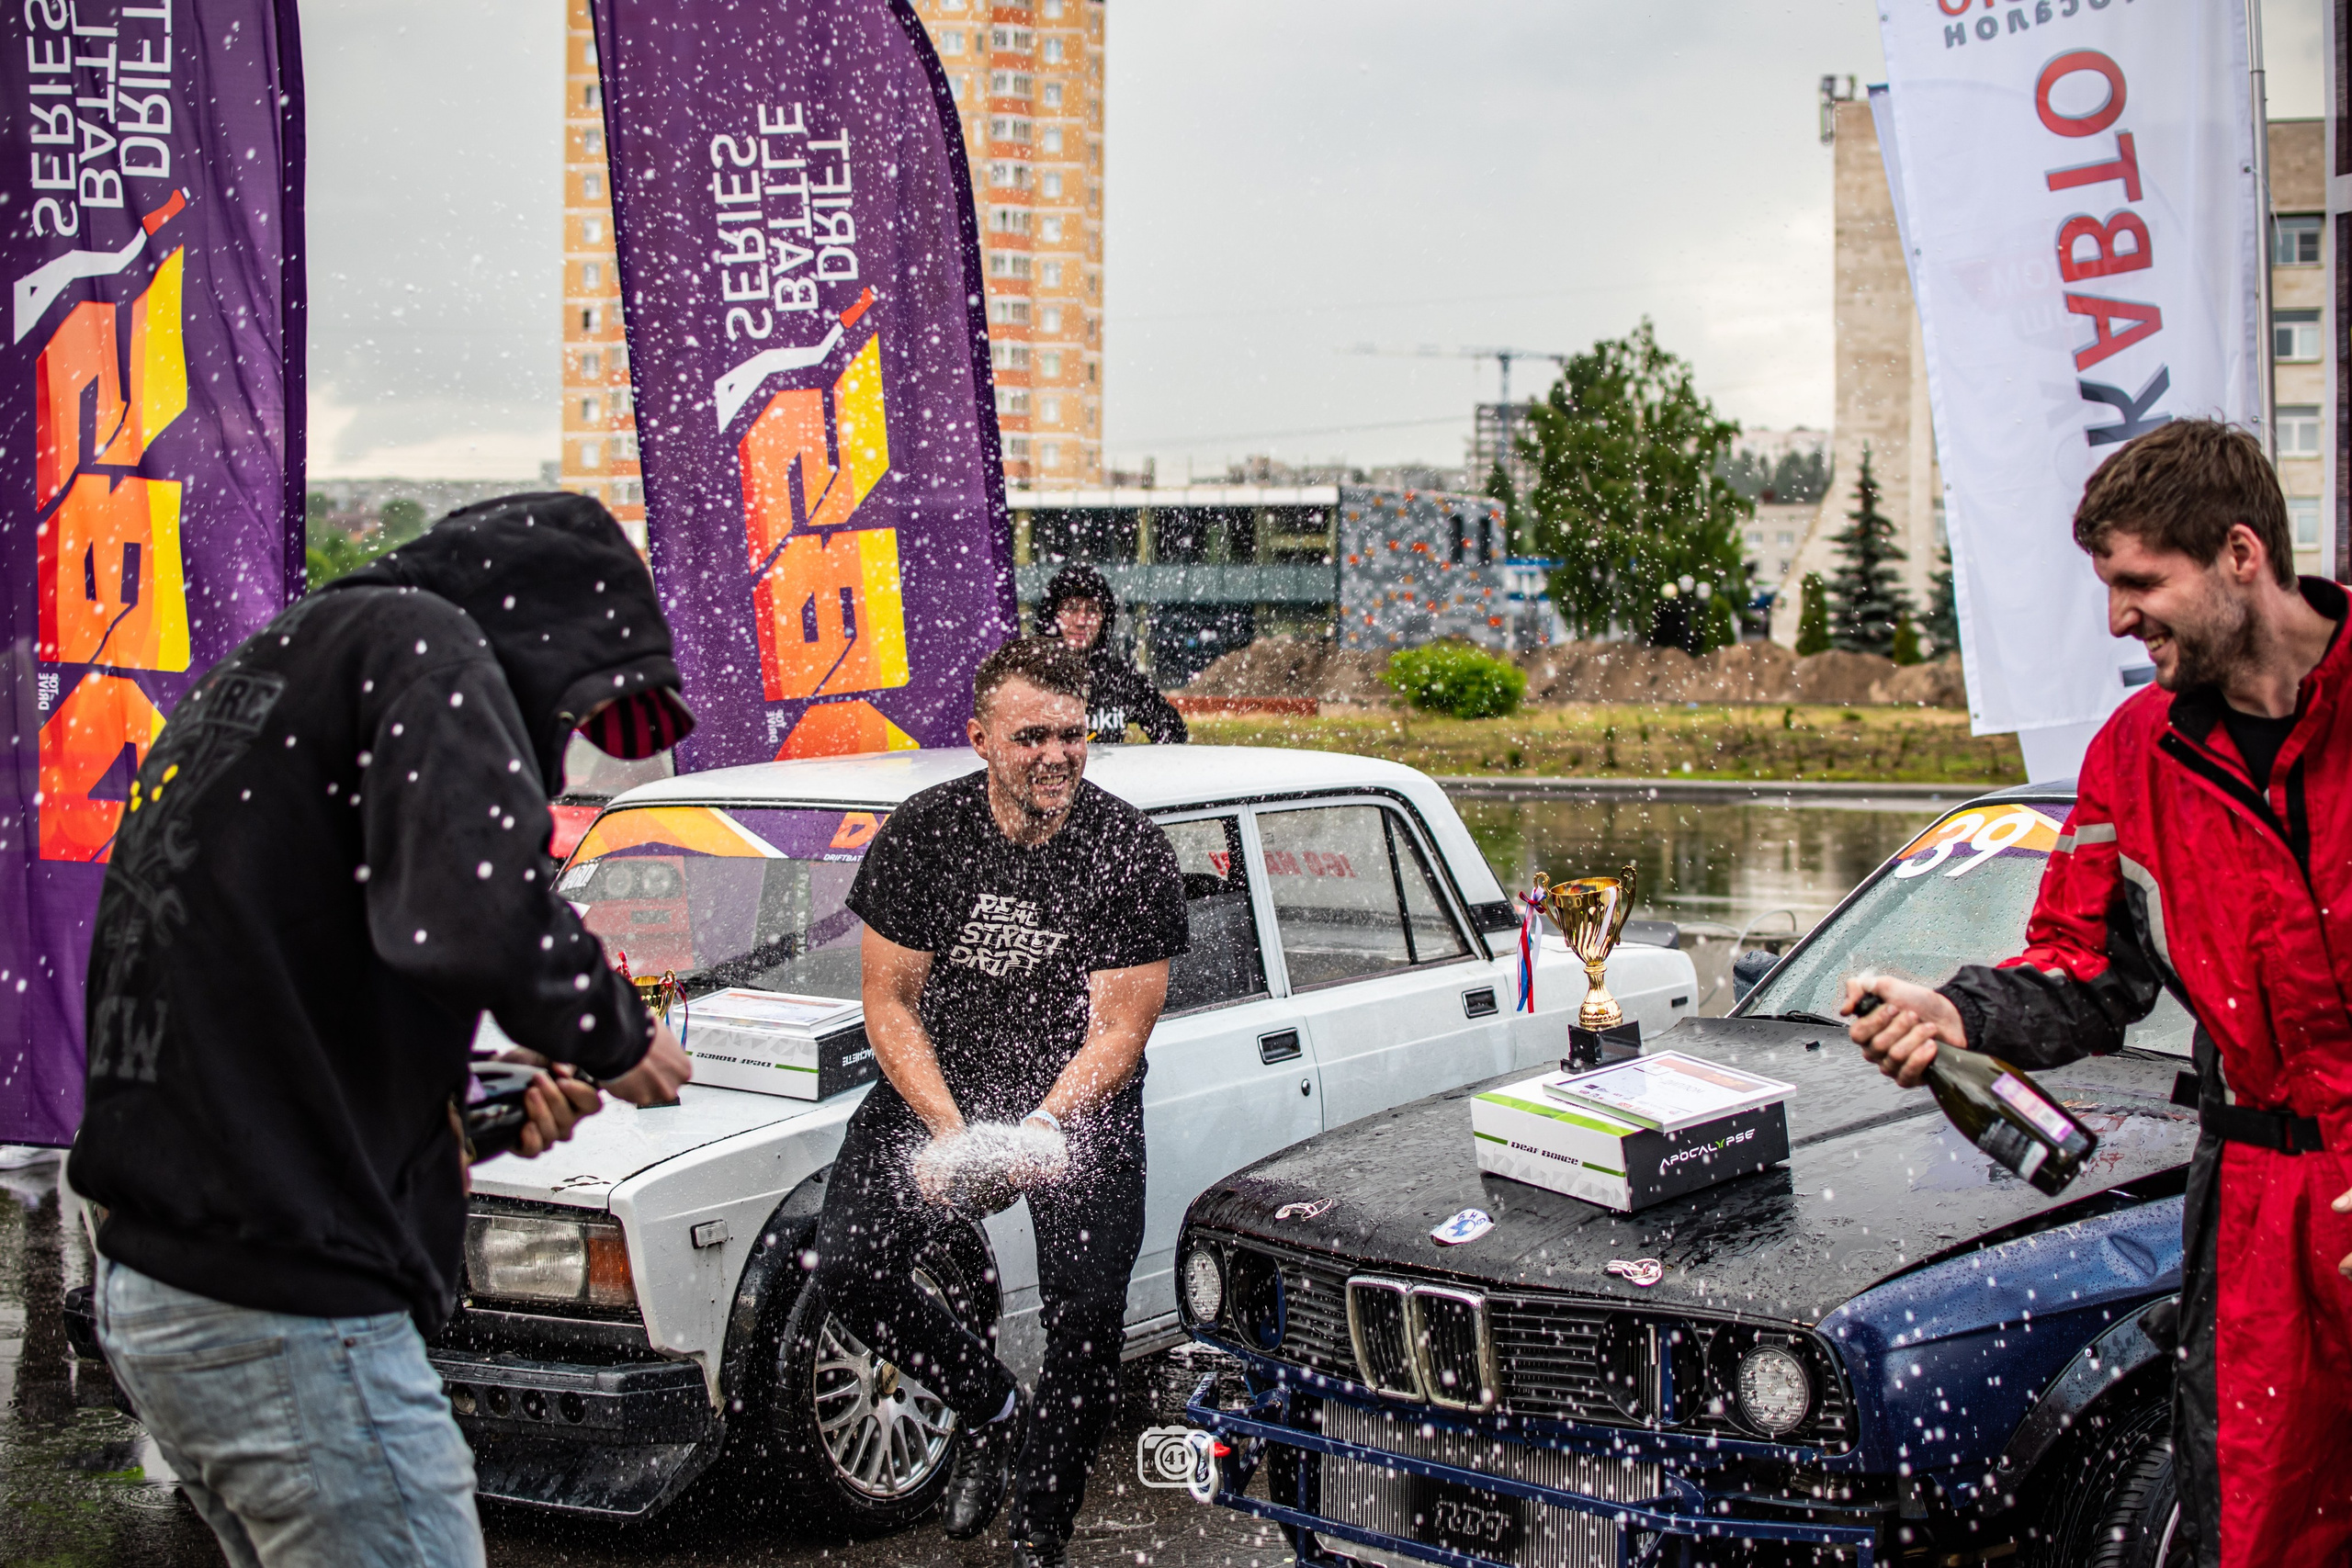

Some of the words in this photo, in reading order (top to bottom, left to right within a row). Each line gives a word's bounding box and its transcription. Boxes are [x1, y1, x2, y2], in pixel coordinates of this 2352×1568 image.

[823, 853, 865, 863] DRIFTBAT
[1894, 812, 2037, 879] 39
[971, 893, 1043, 927] REAL
[796, 910, 807, 963] TAKATA
[959, 921, 1069, 955] STREET
[949, 944, 1041, 977] DRIFT
[1659, 1128, 1756, 1168] APOCALYPSE
